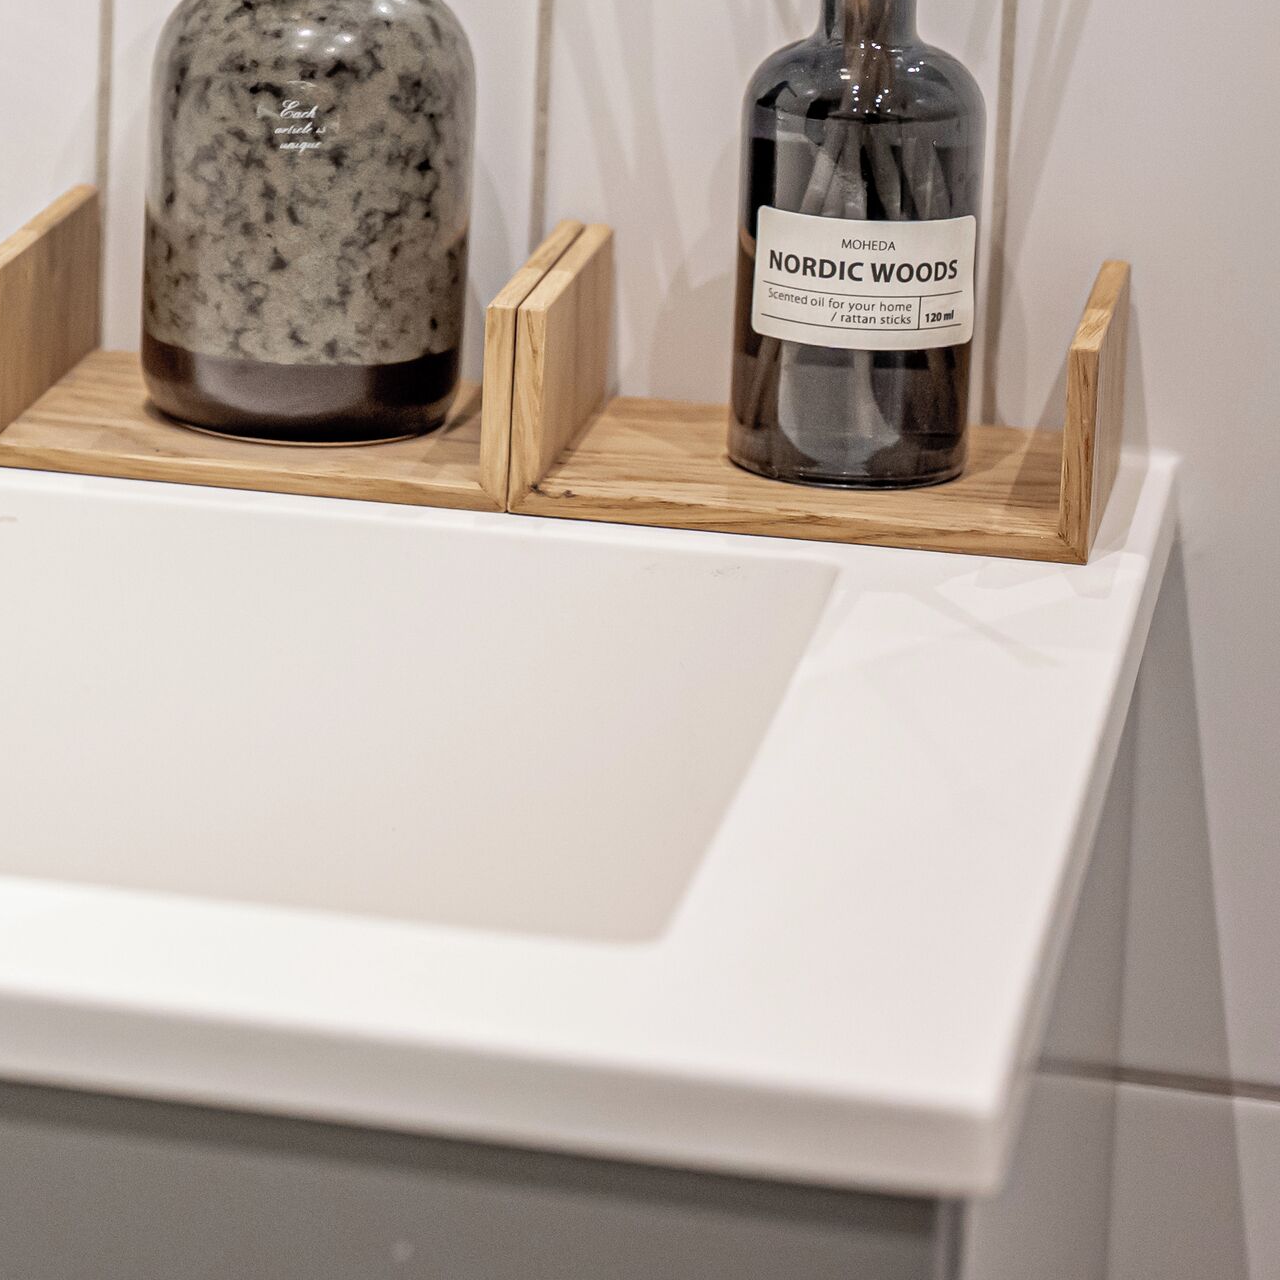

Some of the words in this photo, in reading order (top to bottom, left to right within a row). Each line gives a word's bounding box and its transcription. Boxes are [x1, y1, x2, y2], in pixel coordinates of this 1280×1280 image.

[841, 239, 896, 251] MOHEDA
[769, 250, 864, 282] NORDIC
[871, 259, 958, 282] WOODS
[768, 288, 807, 305] Scented
[811, 296, 824, 307] oil
[828, 299, 844, 309] for
[848, 302, 875, 312] your
[879, 302, 912, 312] home
[841, 314, 876, 324] rattan
[880, 314, 911, 324] sticks
[925, 313, 942, 323] 120
[944, 310, 954, 321] ml
